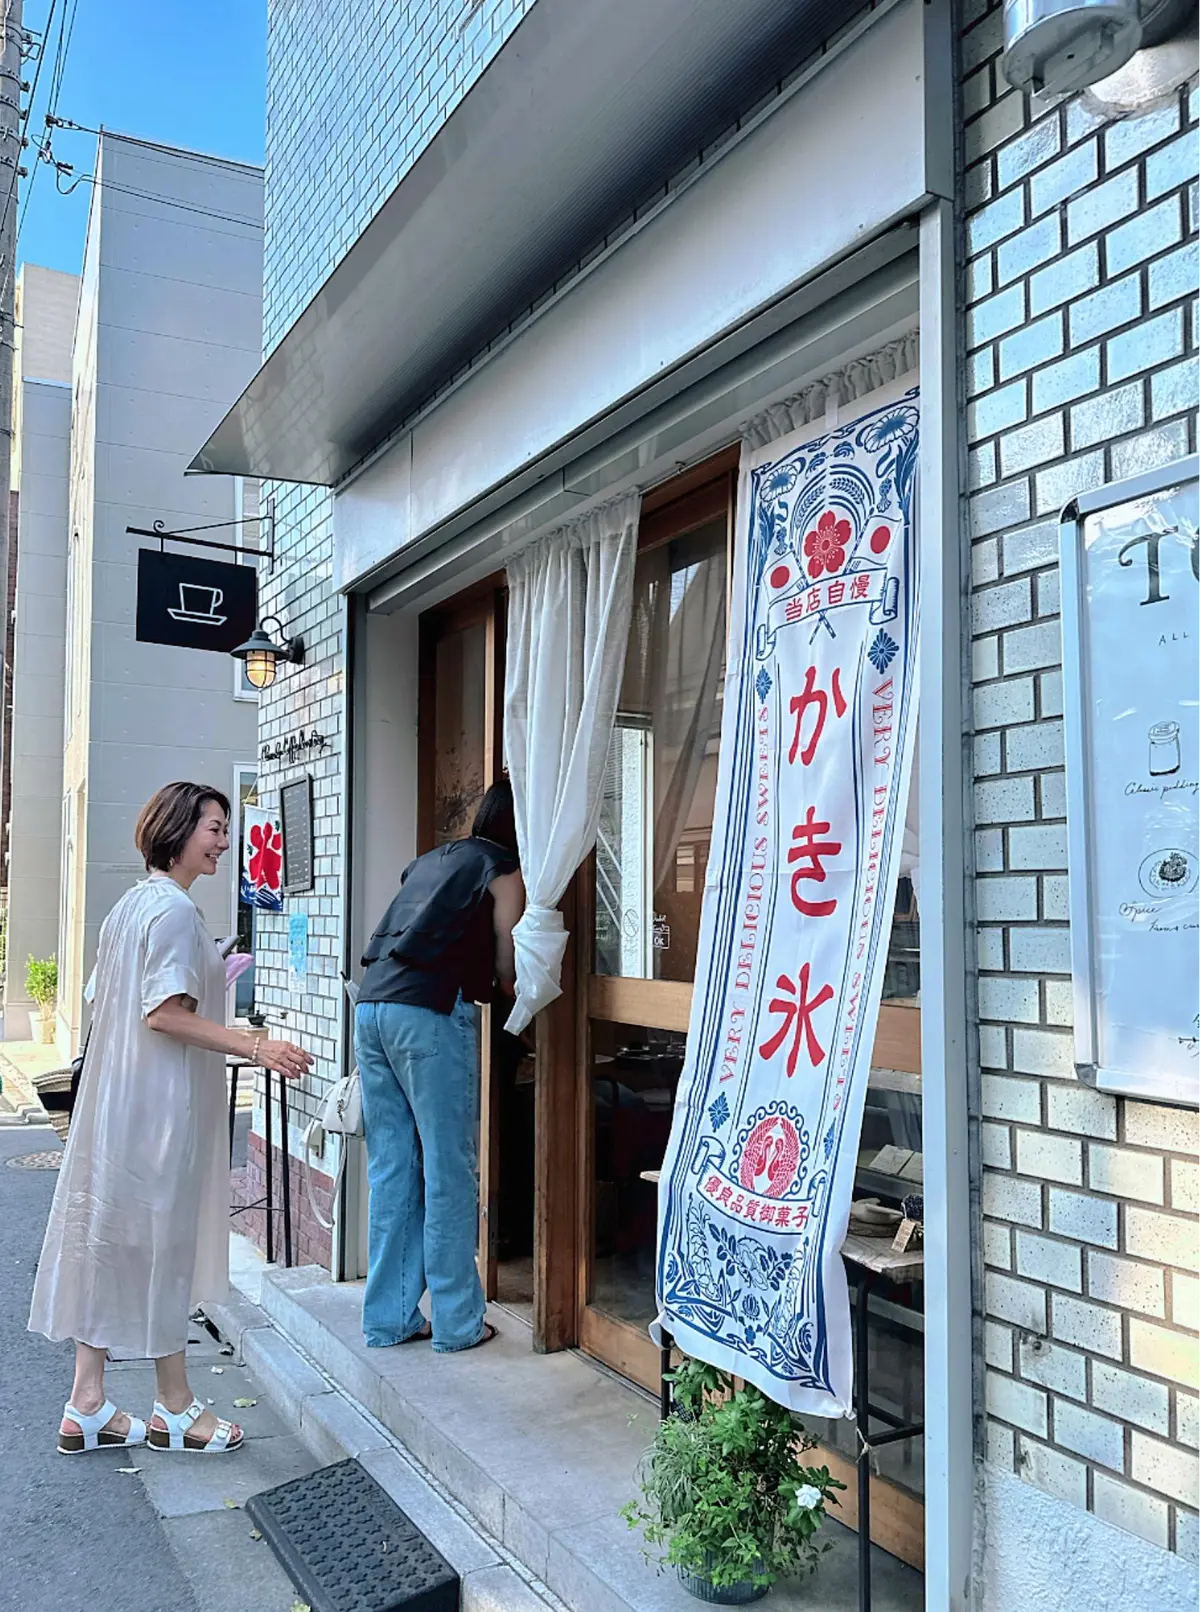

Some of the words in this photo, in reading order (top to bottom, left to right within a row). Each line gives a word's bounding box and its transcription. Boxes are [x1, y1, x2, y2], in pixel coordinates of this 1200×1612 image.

[785, 574, 870, 622] 当店自慢
[1118, 525, 1200, 605] T
[1158, 631, 1190, 647] ALL
[872, 676, 895, 770] VERY
[718, 1001, 746, 1084] VERY
[735, 837, 768, 990] DELICIOUS
[756, 706, 770, 826] SWEETS
[758, 665, 848, 1077] かき氷
[703, 1174, 809, 1230] 優良品質御菓子
